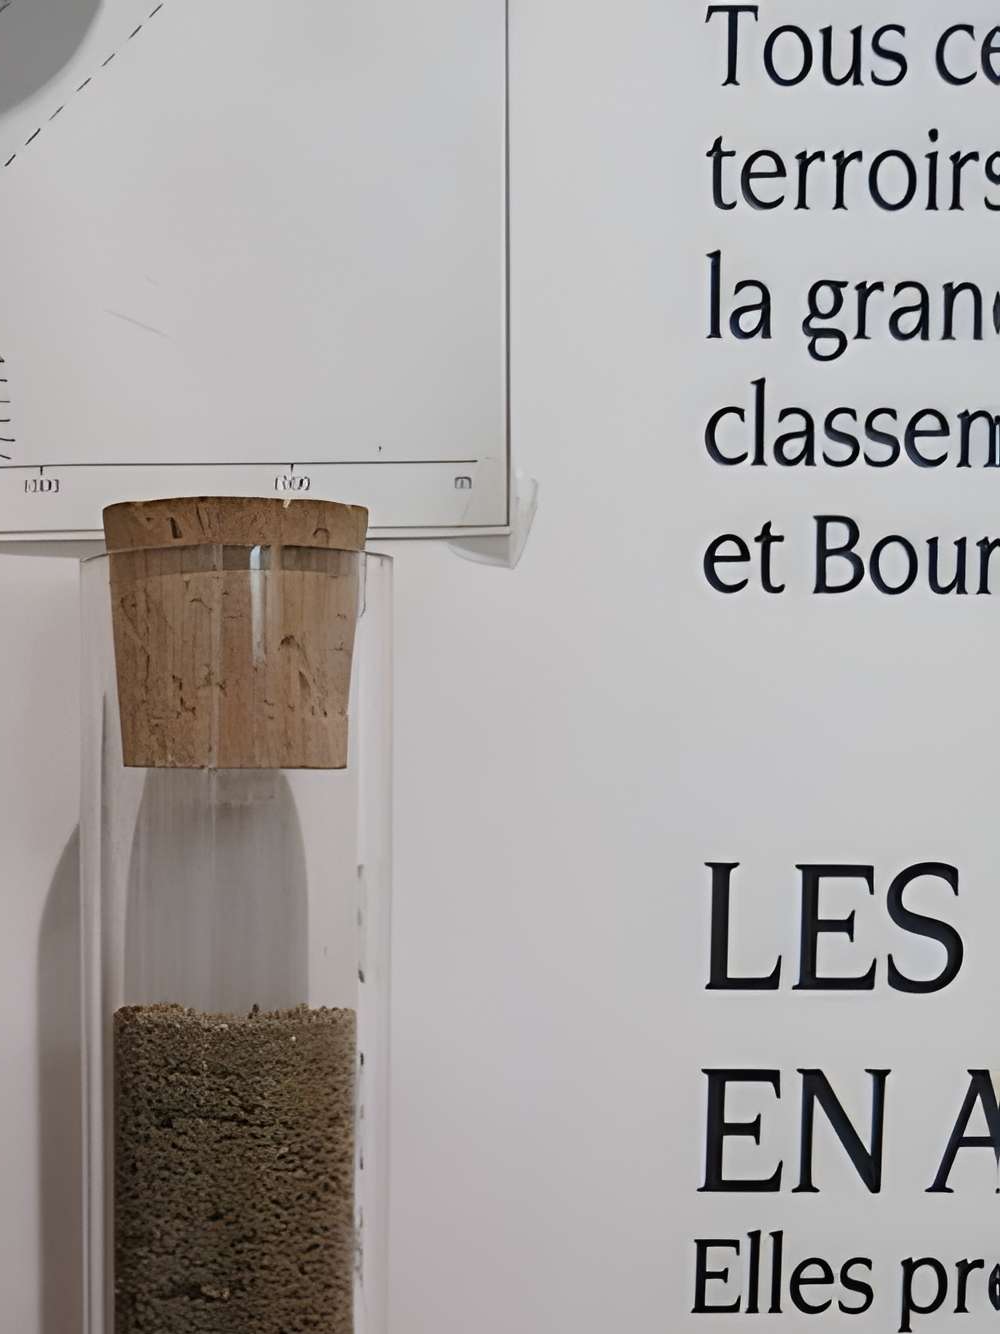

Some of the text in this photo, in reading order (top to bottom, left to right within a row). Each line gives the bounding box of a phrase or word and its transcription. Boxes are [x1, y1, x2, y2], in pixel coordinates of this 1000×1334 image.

[705, 5, 908, 87] Tous
[706, 249, 1000, 362] la gran
[703, 515, 1000, 595] et Bour
[704, 862, 963, 994] LES
[696, 1068, 892, 1194] EN
[690, 1230, 1000, 1333] Elles pr
